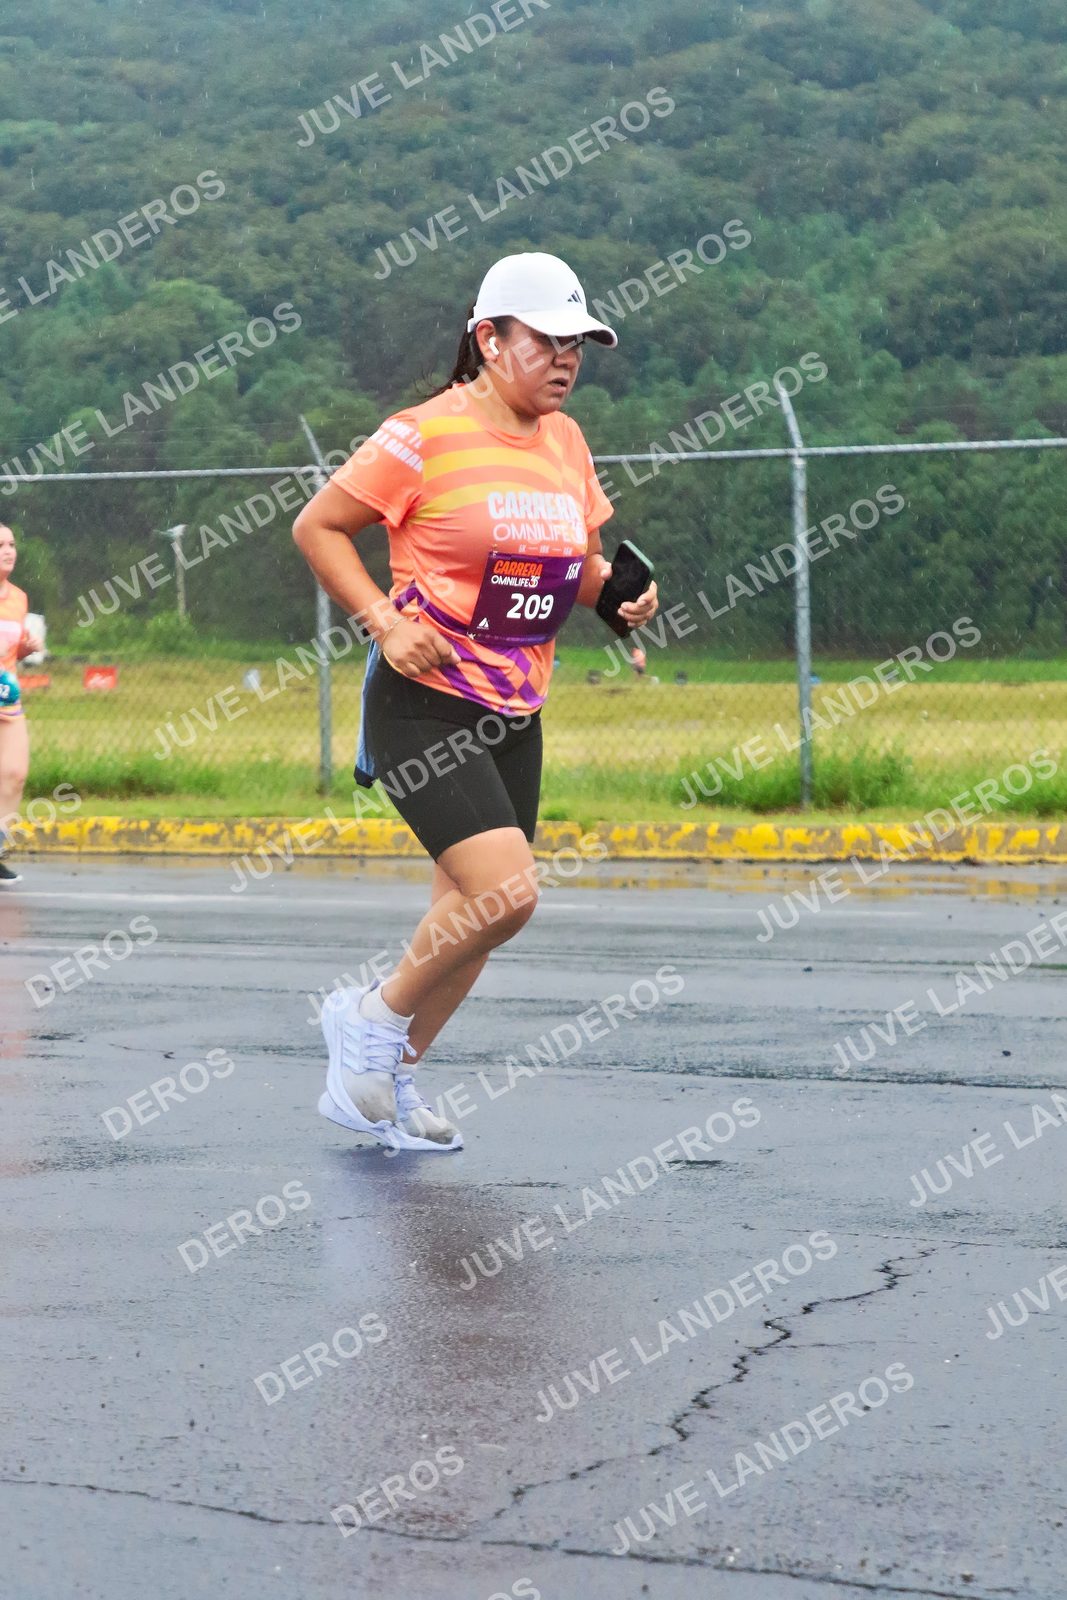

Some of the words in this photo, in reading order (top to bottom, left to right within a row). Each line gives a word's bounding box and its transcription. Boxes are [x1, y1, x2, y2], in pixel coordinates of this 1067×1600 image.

[488, 491, 581, 520] CARRERA
[493, 560, 544, 577] CARRERA
[506, 592, 554, 620] 209
